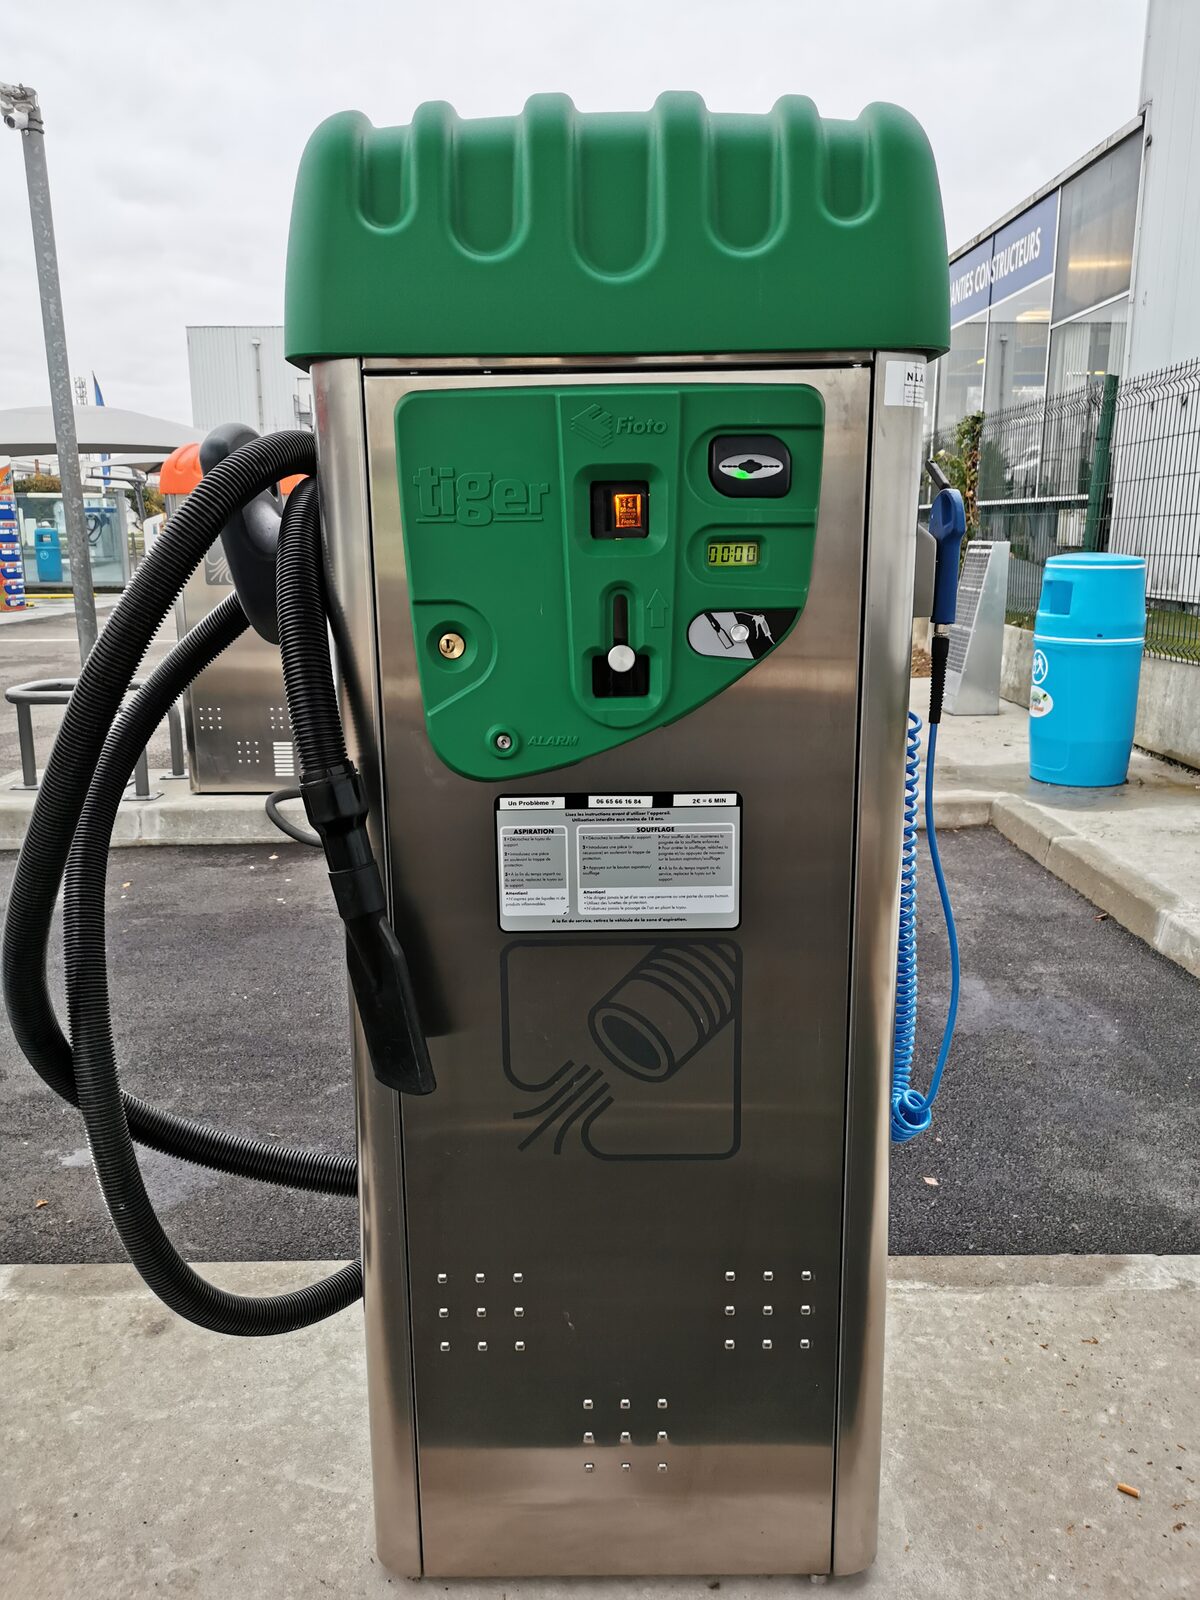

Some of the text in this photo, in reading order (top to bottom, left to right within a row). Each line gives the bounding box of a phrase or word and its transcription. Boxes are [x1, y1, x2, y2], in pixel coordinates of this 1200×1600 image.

[974, 226, 1042, 294] CONSTRUCTEURS
[616, 416, 668, 436] Fioto
[412, 466, 550, 526] tiger
[708, 545, 756, 563] 00:00
[528, 735, 580, 746] ALARM
